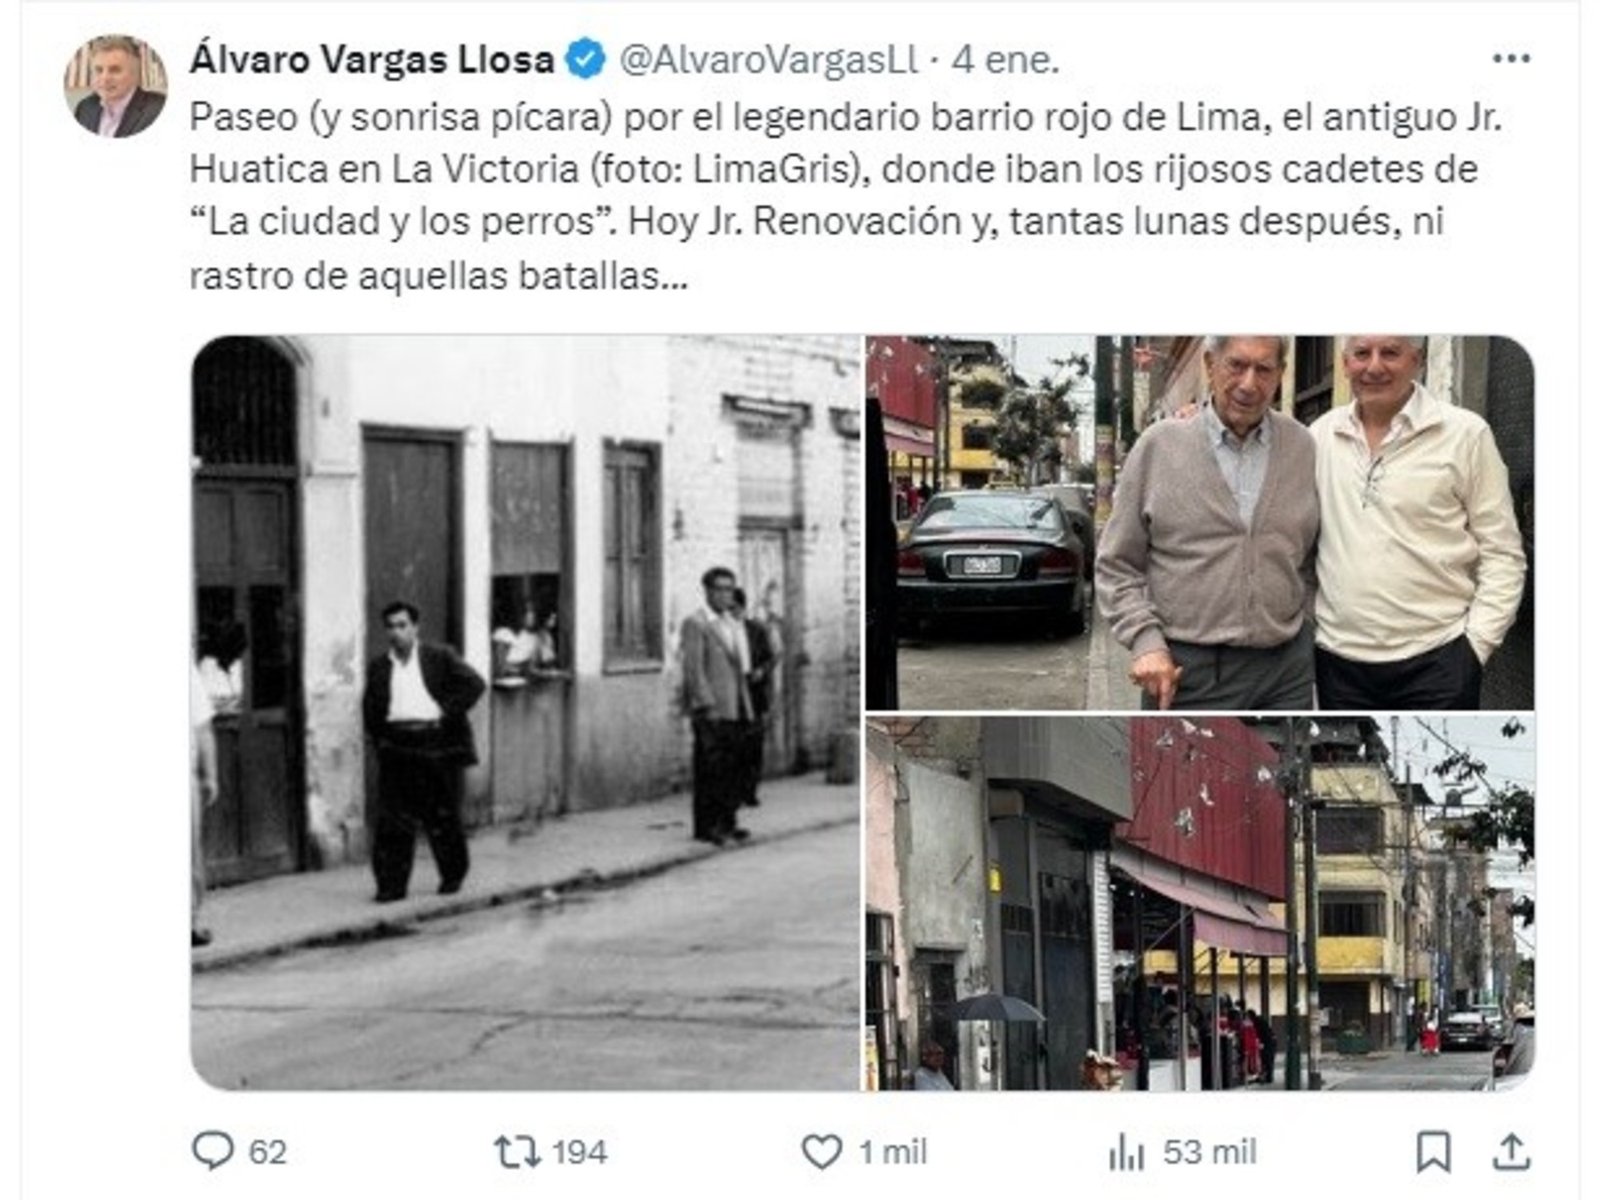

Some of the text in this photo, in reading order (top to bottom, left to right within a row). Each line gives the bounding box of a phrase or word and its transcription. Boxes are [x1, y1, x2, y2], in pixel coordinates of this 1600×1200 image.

[188, 35, 555, 82] Álvaro Vargas Llosa
[620, 43, 1061, 82] @AlvaroVargasLl 4 ene.
[190, 98, 1503, 140] Paseo (y sonrisa pícara) por el legendario barrio rojo de Lima, el antiguo Jr.
[190, 150, 1479, 192] Huatica en La Victoria (foto: LimaGris), donde iban los rijosos cadetes de
[259, 204, 380, 236] ciudad
[389, 212, 411, 244] y
[421, 205, 471, 236] los
[629, 204, 700, 244] Hoy
[707, 204, 743, 236] Jr.
[754, 204, 961, 236] Renovación
[971, 212, 999, 244] y,
[1008, 207, 1124, 236] tantas
[1135, 205, 1229, 236] lunas
[1239, 204, 1402, 243] después,
[1414, 204, 1444, 235] ni
[190, 262, 294, 291] rastro
[304, 259, 348, 291] de
[359, 259, 508, 298] aquellas
[249, 1139, 287, 1165] 62
[552, 1139, 609, 1165] 194
[860, 1137, 928, 1164] 1 mil
[1164, 1137, 1257, 1165] 53 mil
